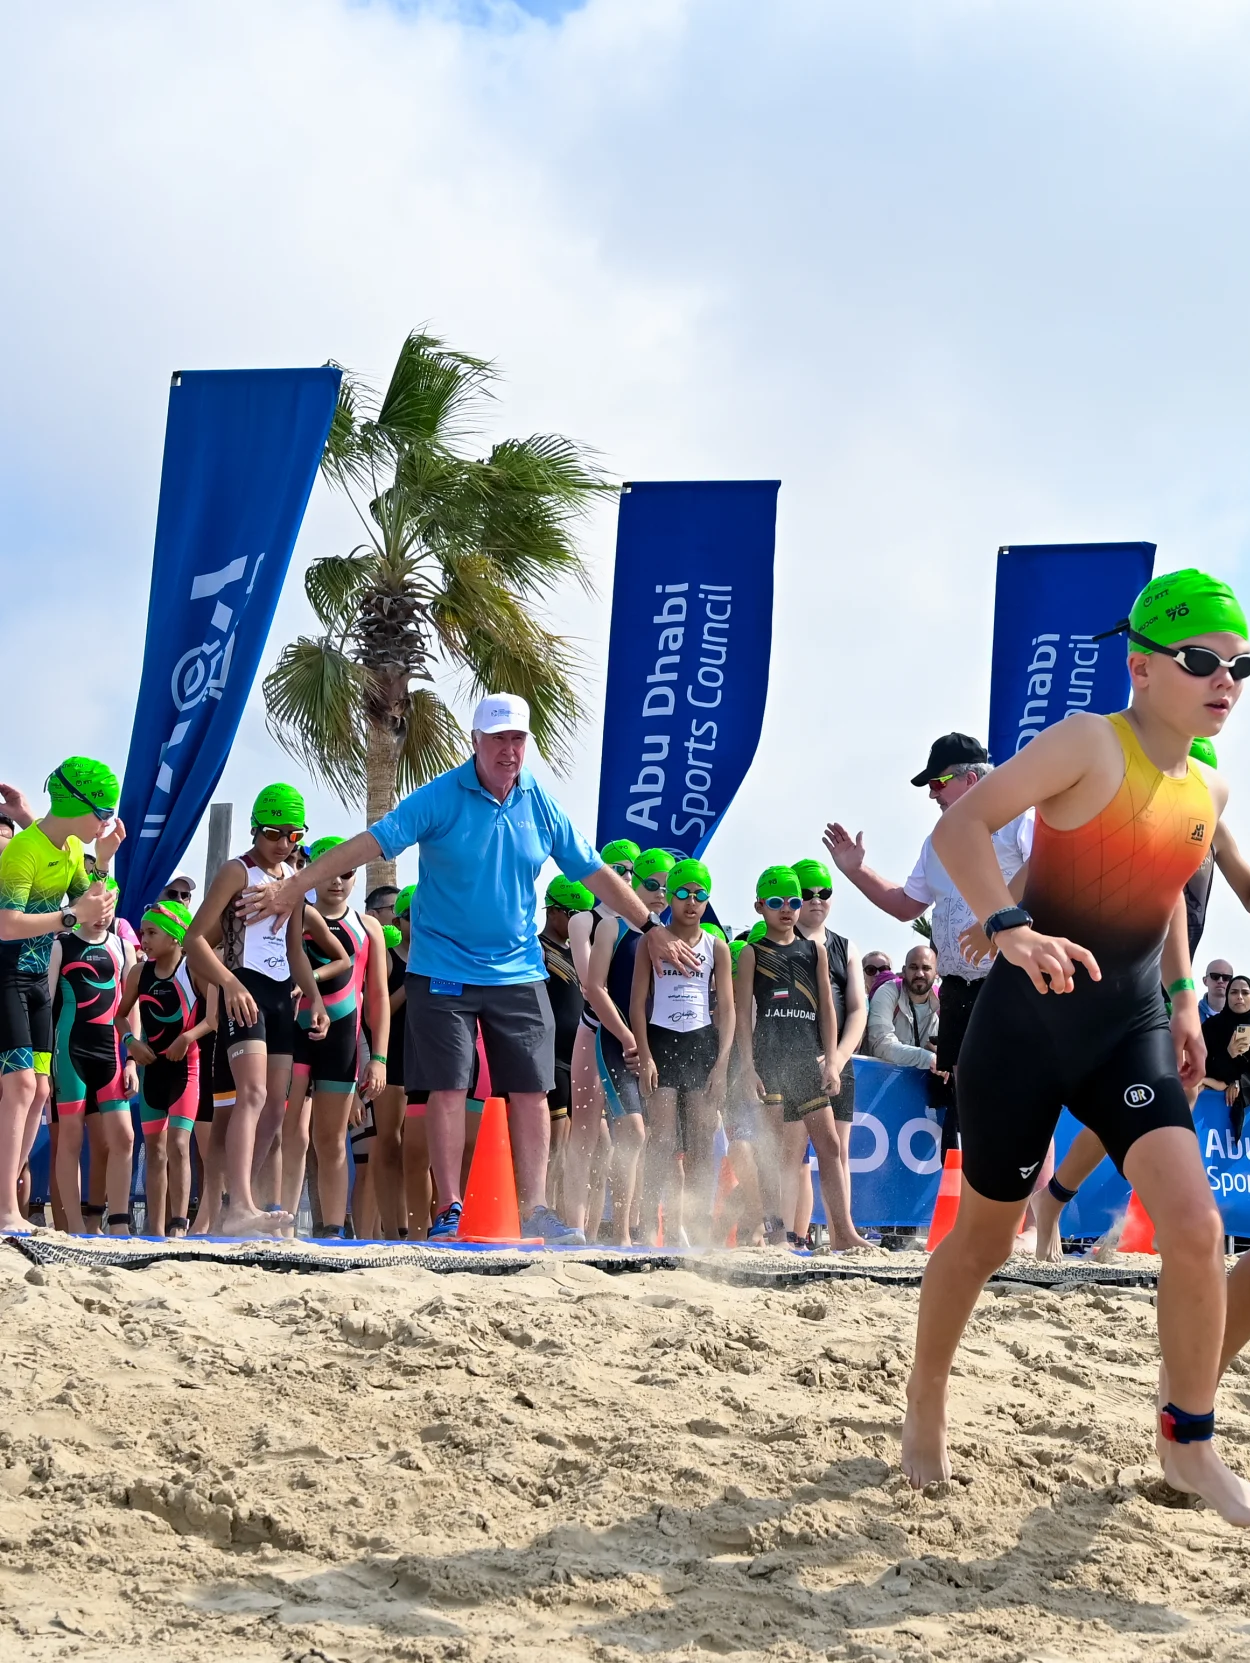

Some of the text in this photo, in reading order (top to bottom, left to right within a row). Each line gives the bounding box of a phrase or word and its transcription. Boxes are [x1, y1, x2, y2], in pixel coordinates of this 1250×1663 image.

[1167, 607, 1190, 622] 70
[625, 582, 690, 832] Abu Dhabi
[670, 584, 733, 838] Sports Council
[662, 969, 705, 978] SEASORE
[1130, 1089, 1148, 1103] BR
